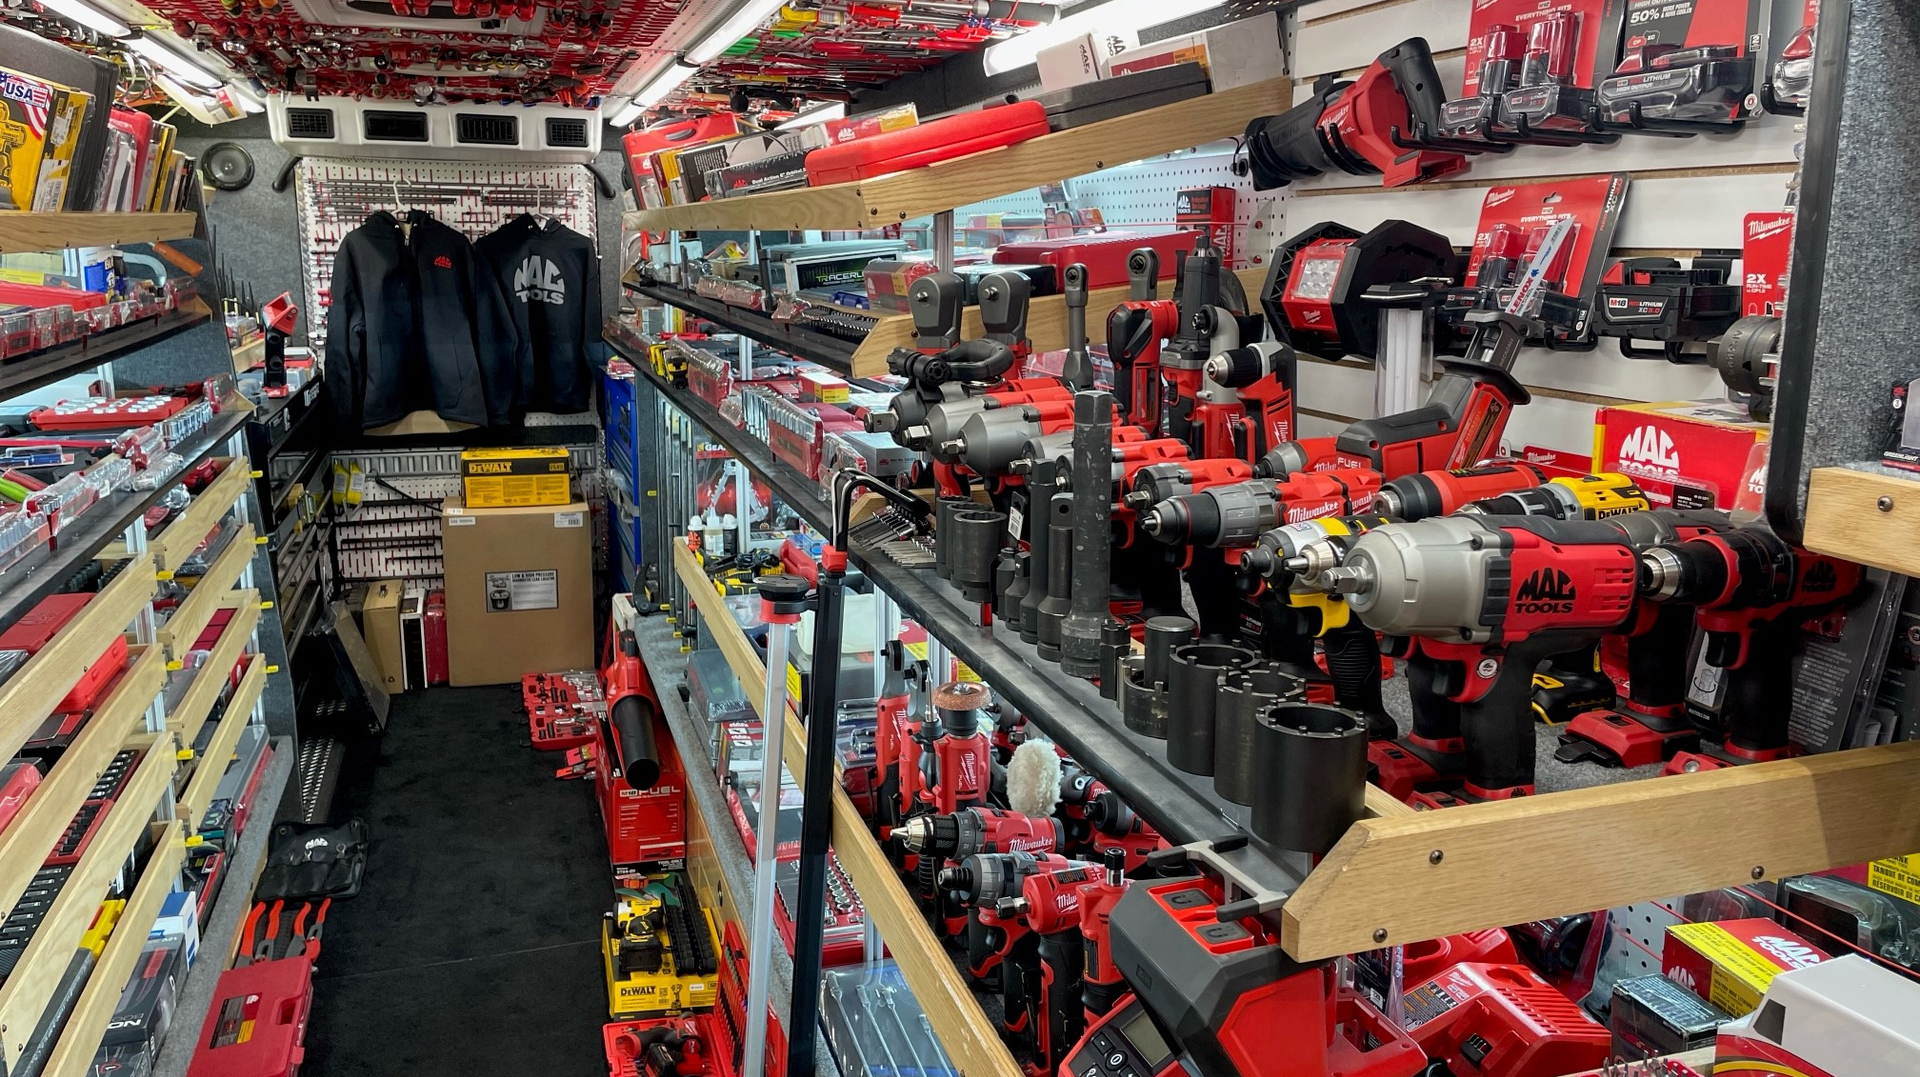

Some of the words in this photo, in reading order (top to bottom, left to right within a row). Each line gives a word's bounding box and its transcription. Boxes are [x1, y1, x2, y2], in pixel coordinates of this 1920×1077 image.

[1515, 9, 1556, 21] EVERYTHING
[1630, 8, 1660, 23] 50%
[1470, 37, 1484, 46] 2X
[5, 82, 34, 101] USA
[763, 174, 779, 183] Action
[1487, 188, 1516, 205] Milwaukee
[1520, 213, 1557, 223] EVERYTHING
[1749, 217, 1791, 236] Milwaukee
[1477, 233, 1490, 241] 2X
[514, 255, 565, 293] MAC
[1746, 273, 1767, 284] 2X
[1510, 277, 1534, 314] LENOX
[1609, 298, 1627, 308] M18
[1619, 425, 1680, 469] MAC
[1528, 452, 1556, 461] Milwaukee
[1619, 459, 1680, 481] TOOLS
[1287, 501, 1338, 525] Milwaukee
[1802, 560, 1837, 583] MAC
[1515, 566, 1577, 601] MAC
[1515, 602, 1574, 614] TOOLS
[964, 751, 977, 785] Milwaukee
[638, 785, 681, 796] FUEL
[1009, 835, 1053, 852] Milwaukee
[1873, 864, 1896, 879] TANQUE
[1897, 873, 1905, 882] DE
[1757, 935, 1820, 964] MAC
